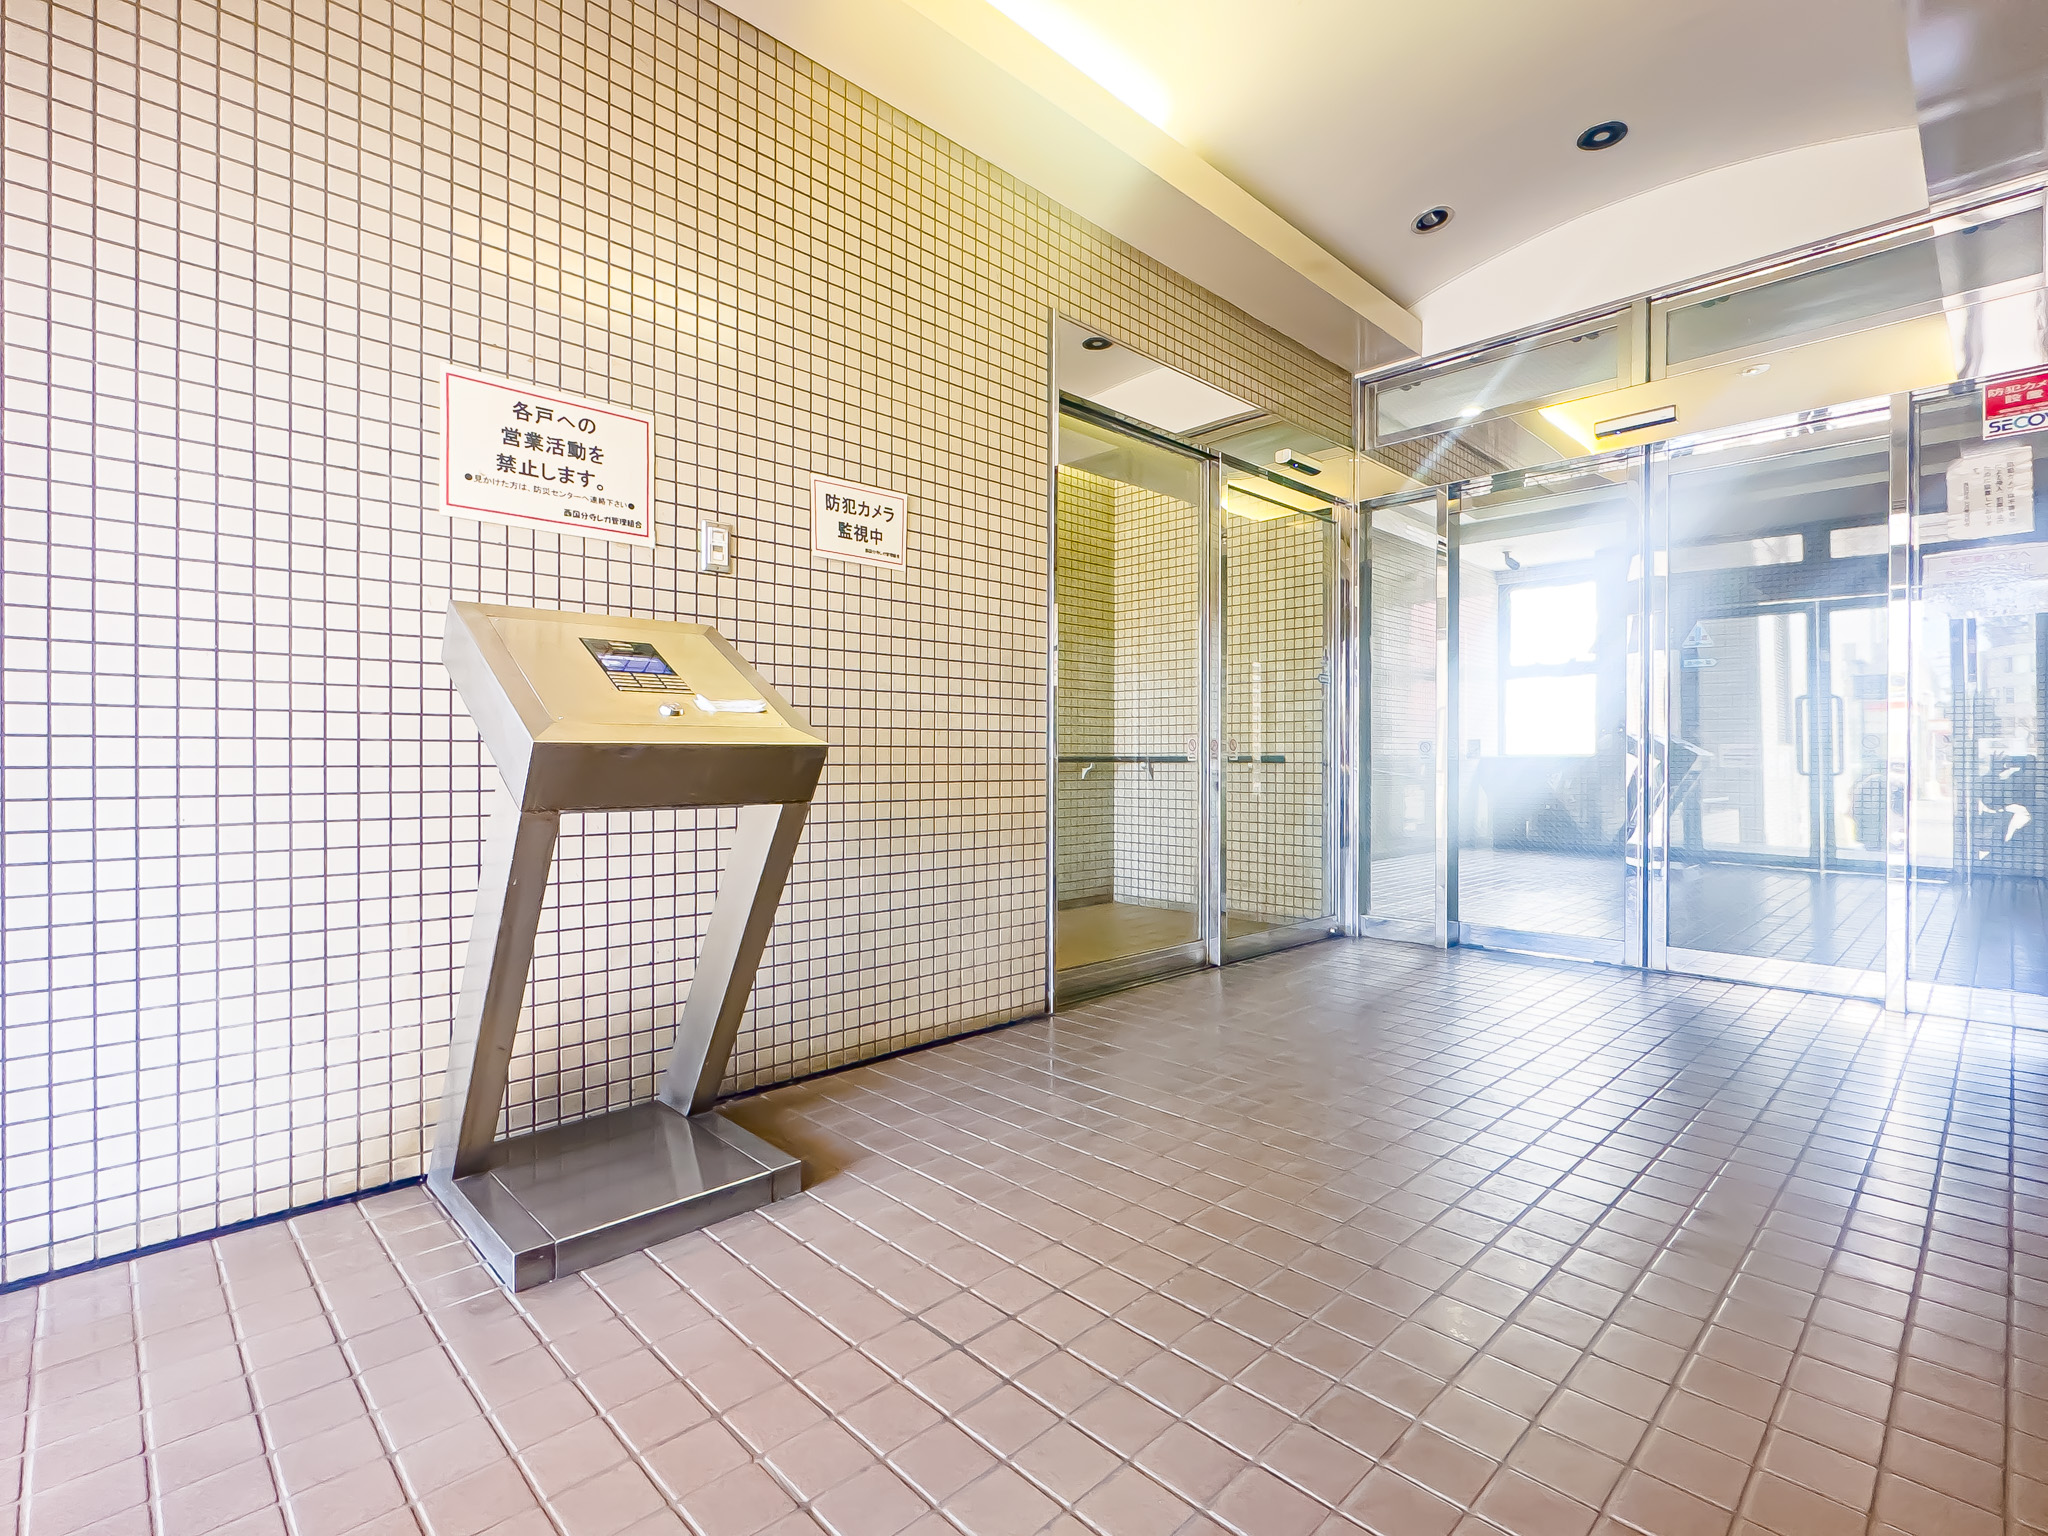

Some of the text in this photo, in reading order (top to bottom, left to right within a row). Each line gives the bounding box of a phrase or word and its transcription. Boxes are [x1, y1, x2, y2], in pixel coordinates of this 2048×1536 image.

[512, 401, 596, 434] 各戸への
[1989, 412, 2048, 433] SECO
[501, 426, 604, 465] 営業活動を
[496, 453, 604, 491] 禁止します。
[825, 493, 894, 522] 防犯カメラ
[837, 521, 883, 545] 監視中
